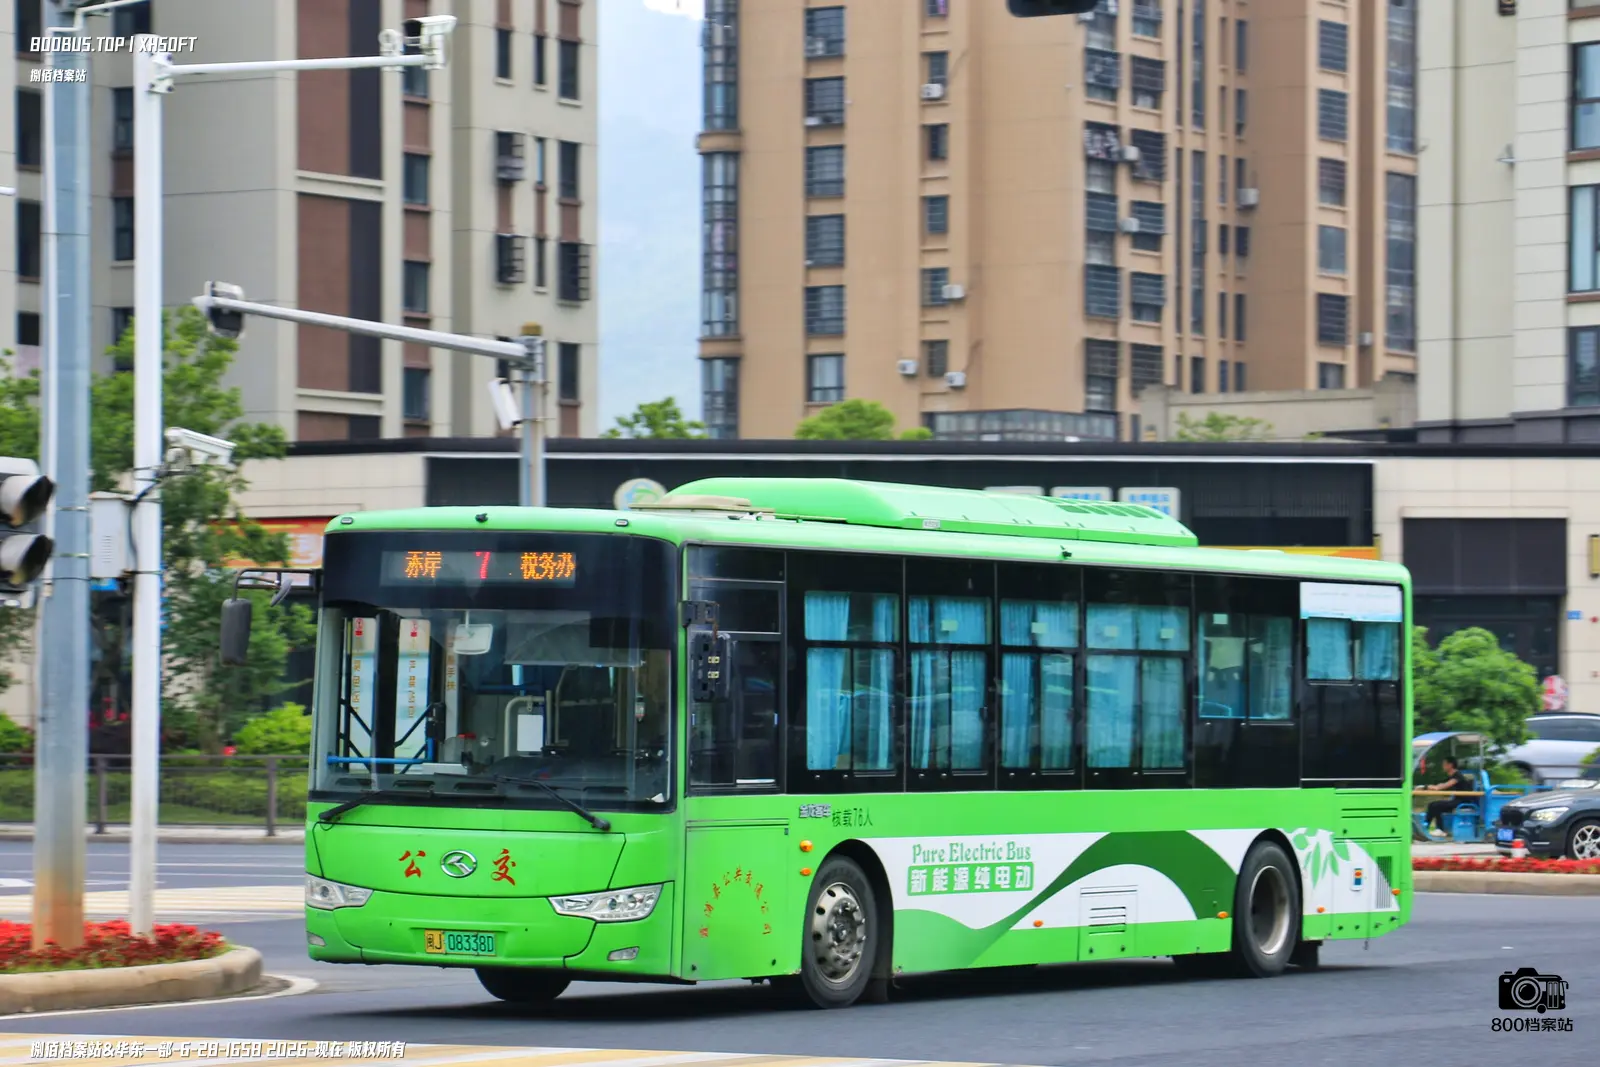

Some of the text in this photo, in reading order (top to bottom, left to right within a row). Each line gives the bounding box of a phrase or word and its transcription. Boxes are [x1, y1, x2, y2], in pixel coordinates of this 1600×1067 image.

[475, 551, 491, 579] 7
[912, 841, 1031, 863] Pure Electric Bus
[399, 848, 516, 886] 公 交
[911, 865, 1031, 893] 新能源纯电动
